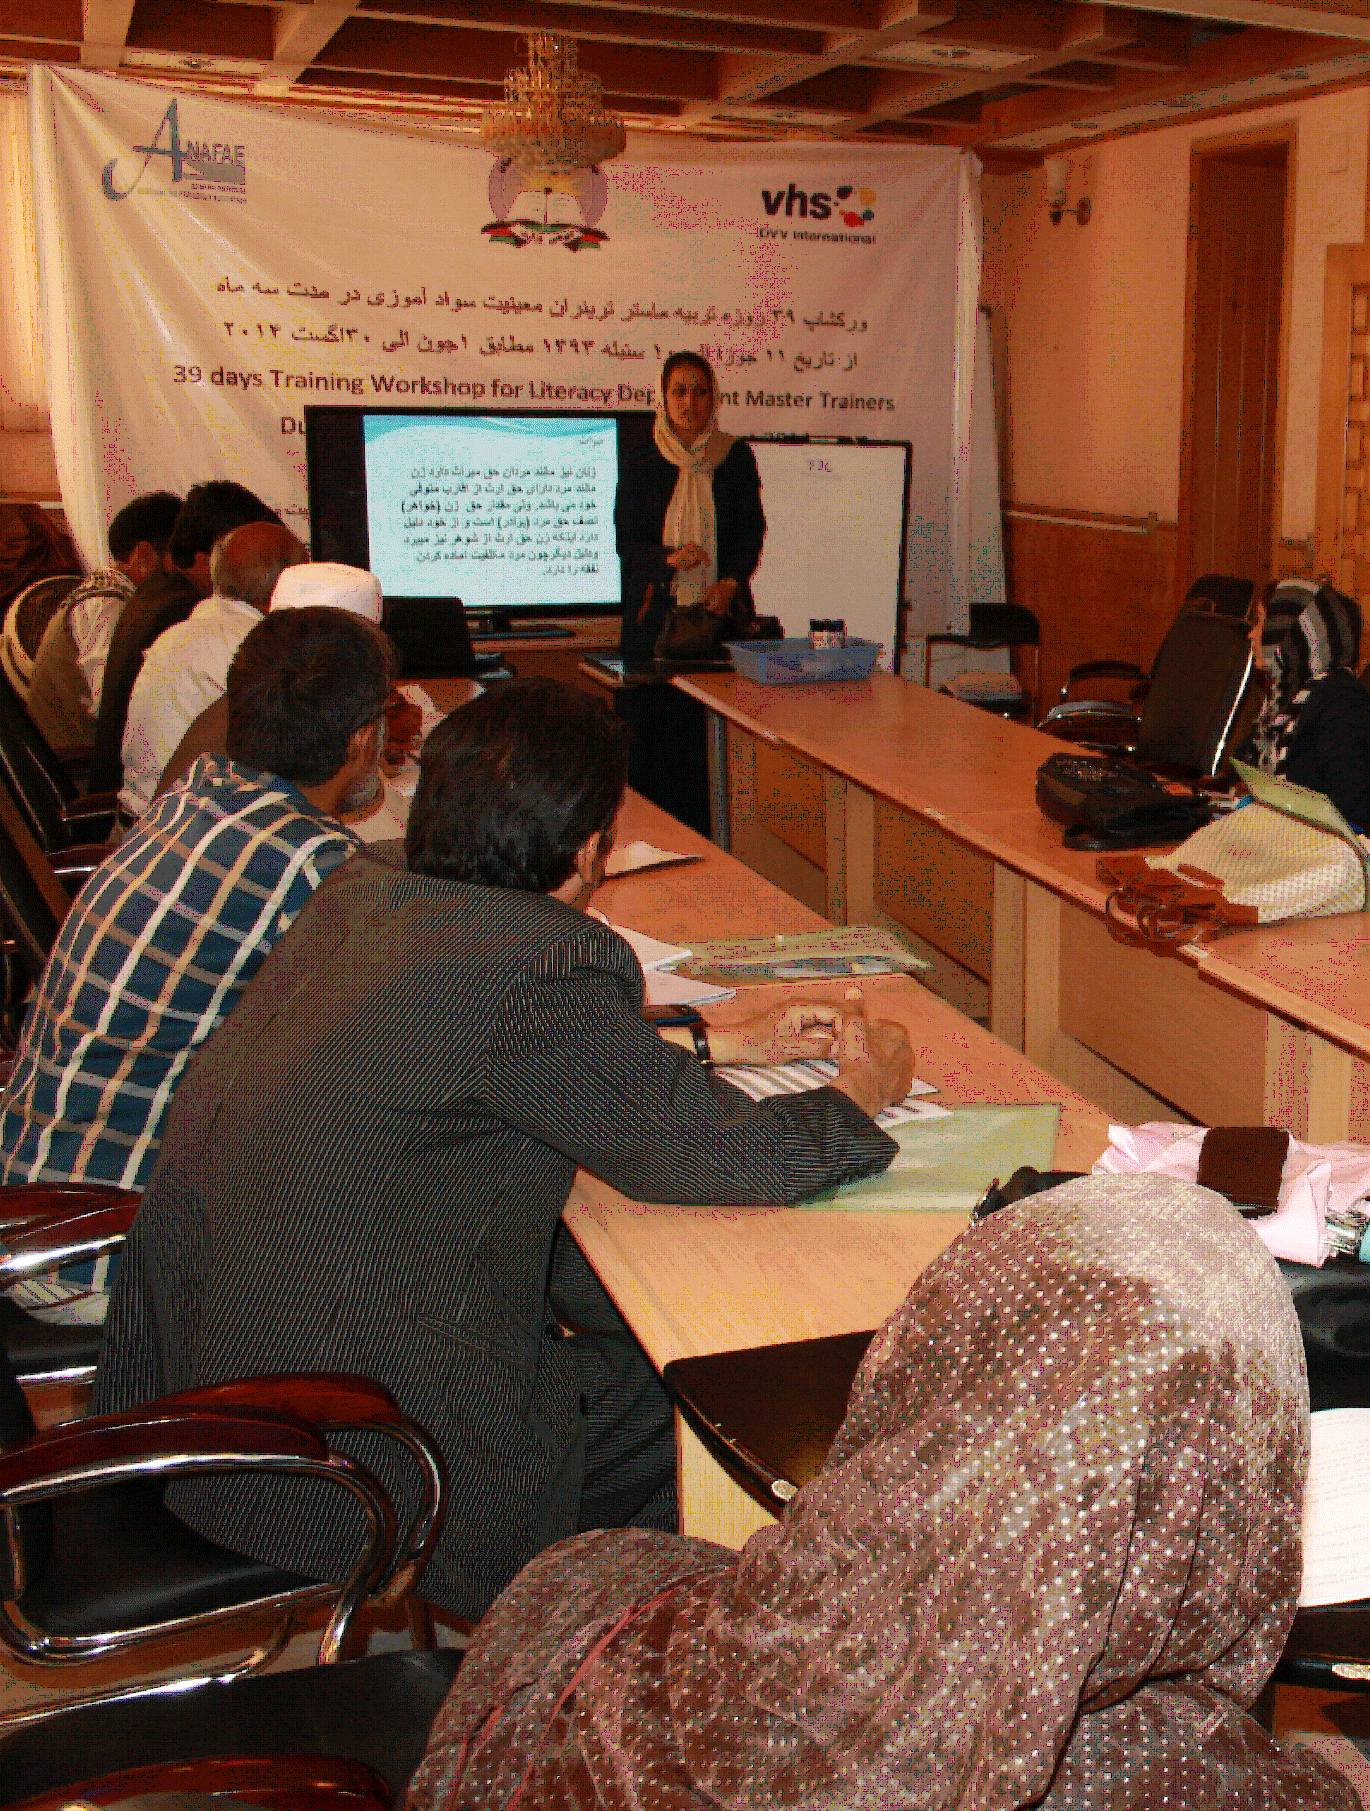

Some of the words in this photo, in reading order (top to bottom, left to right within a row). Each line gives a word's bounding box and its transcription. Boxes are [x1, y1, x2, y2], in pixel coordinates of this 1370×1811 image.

[761, 182, 832, 220] vhs
[793, 230, 876, 245] International
[217, 276, 244, 292] ماه
[252, 282, 279, 294] سه
[287, 282, 329, 299] مدت
[337, 289, 361, 306] در
[435, 290, 476, 313] سواد
[620, 302, 669, 322] ماستر
[479, 334, 534, 356] مطابق
[794, 351, 835, 372] تاریخ
[843, 352, 858, 372] از
[173, 364, 203, 384] 39
[210, 365, 263, 391] days
[269, 369, 364, 395] Training
[370, 374, 485, 400] Workshop
[491, 378, 523, 398] for
[529, 381, 613, 405] Literacy
[746, 390, 813, 408] Master
[819, 390, 896, 411] Trainers
[484, 469, 499, 480] حق
[507, 484, 523, 495] حق
[466, 501, 482, 512] حق
